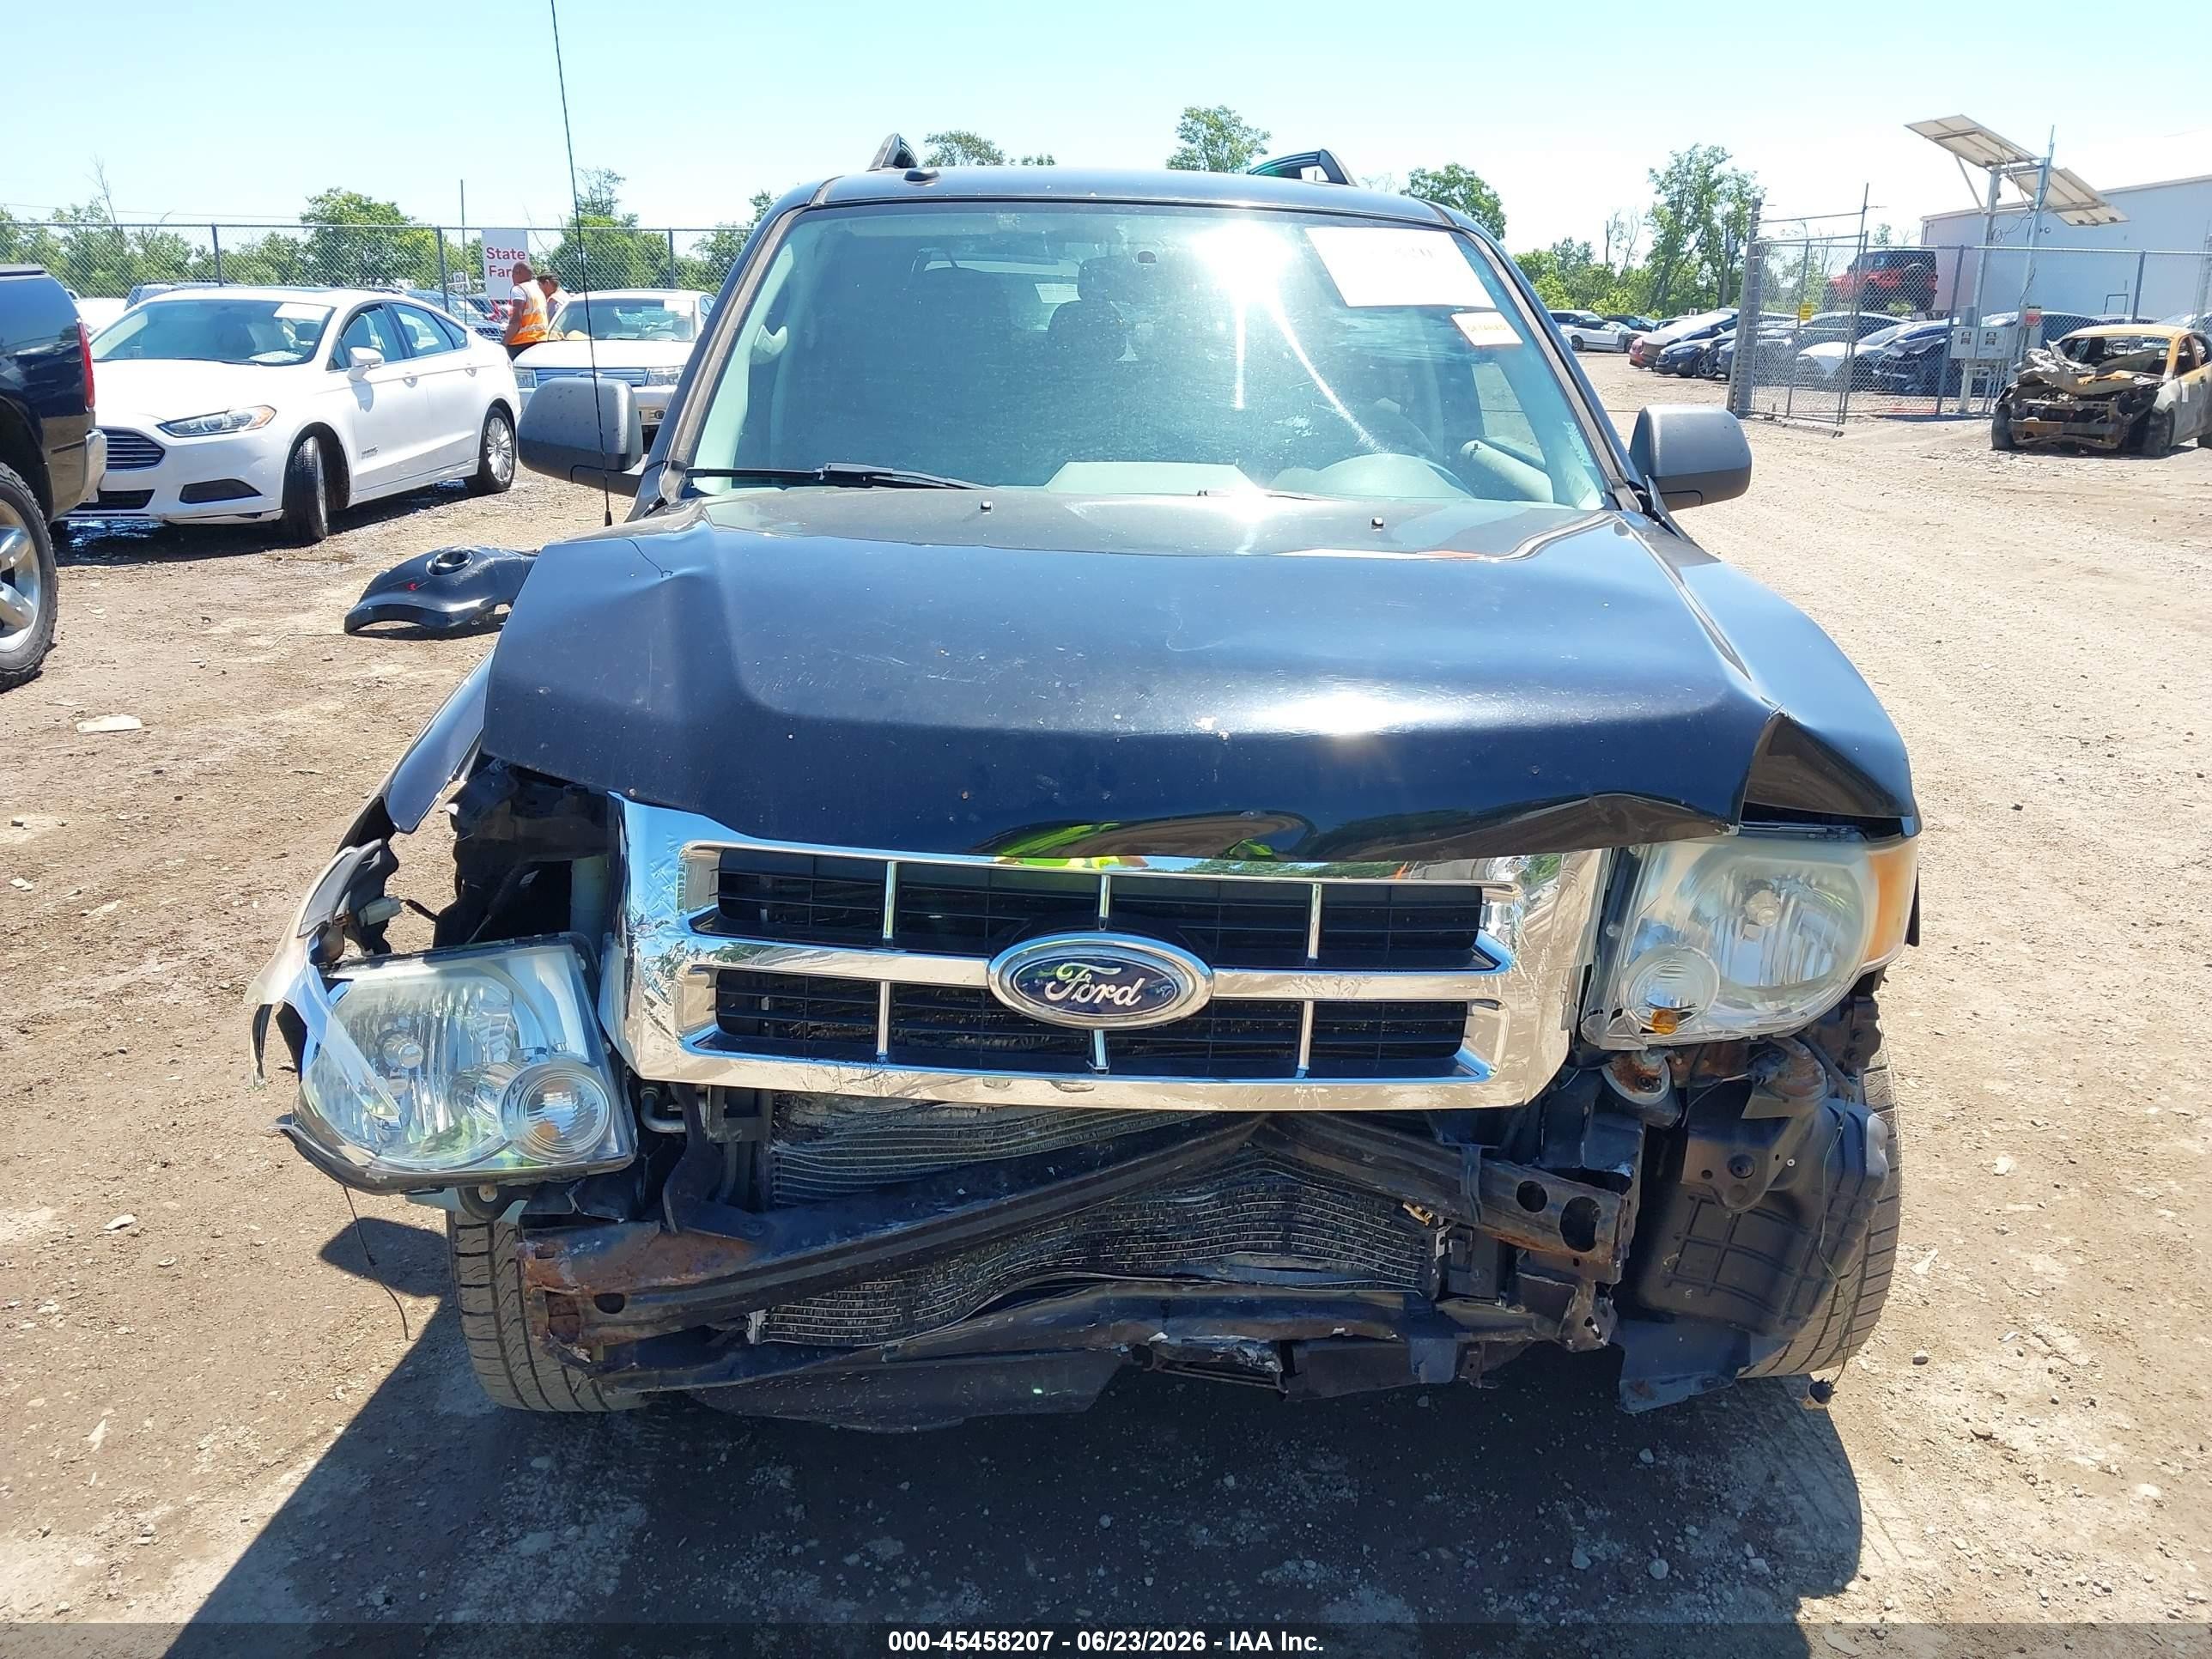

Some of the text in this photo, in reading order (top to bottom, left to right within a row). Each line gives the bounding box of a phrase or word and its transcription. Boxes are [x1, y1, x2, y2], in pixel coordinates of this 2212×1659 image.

[486, 246, 526, 260] State
[489, 264, 513, 277] Far
[1043, 962, 1146, 1006] Ford
